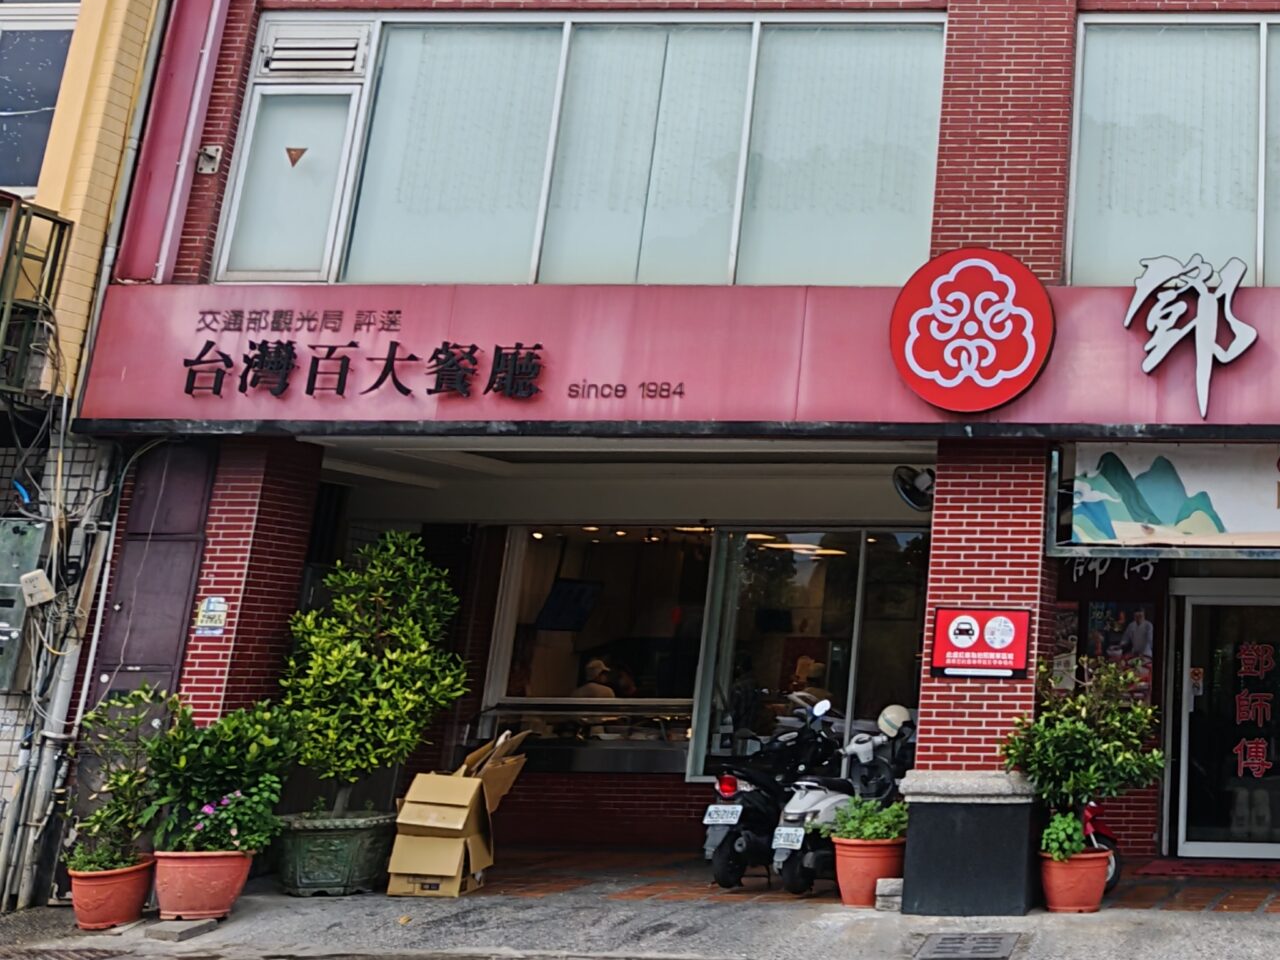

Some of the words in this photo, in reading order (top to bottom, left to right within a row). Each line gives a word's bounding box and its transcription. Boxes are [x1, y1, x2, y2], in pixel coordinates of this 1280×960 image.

[196, 309, 344, 333] 交通部觀光局
[183, 339, 545, 398] 台灣百大餐廳
[568, 379, 627, 399] since
[638, 382, 685, 399] 1984
[1232, 641, 1277, 779] 鄧師傅
